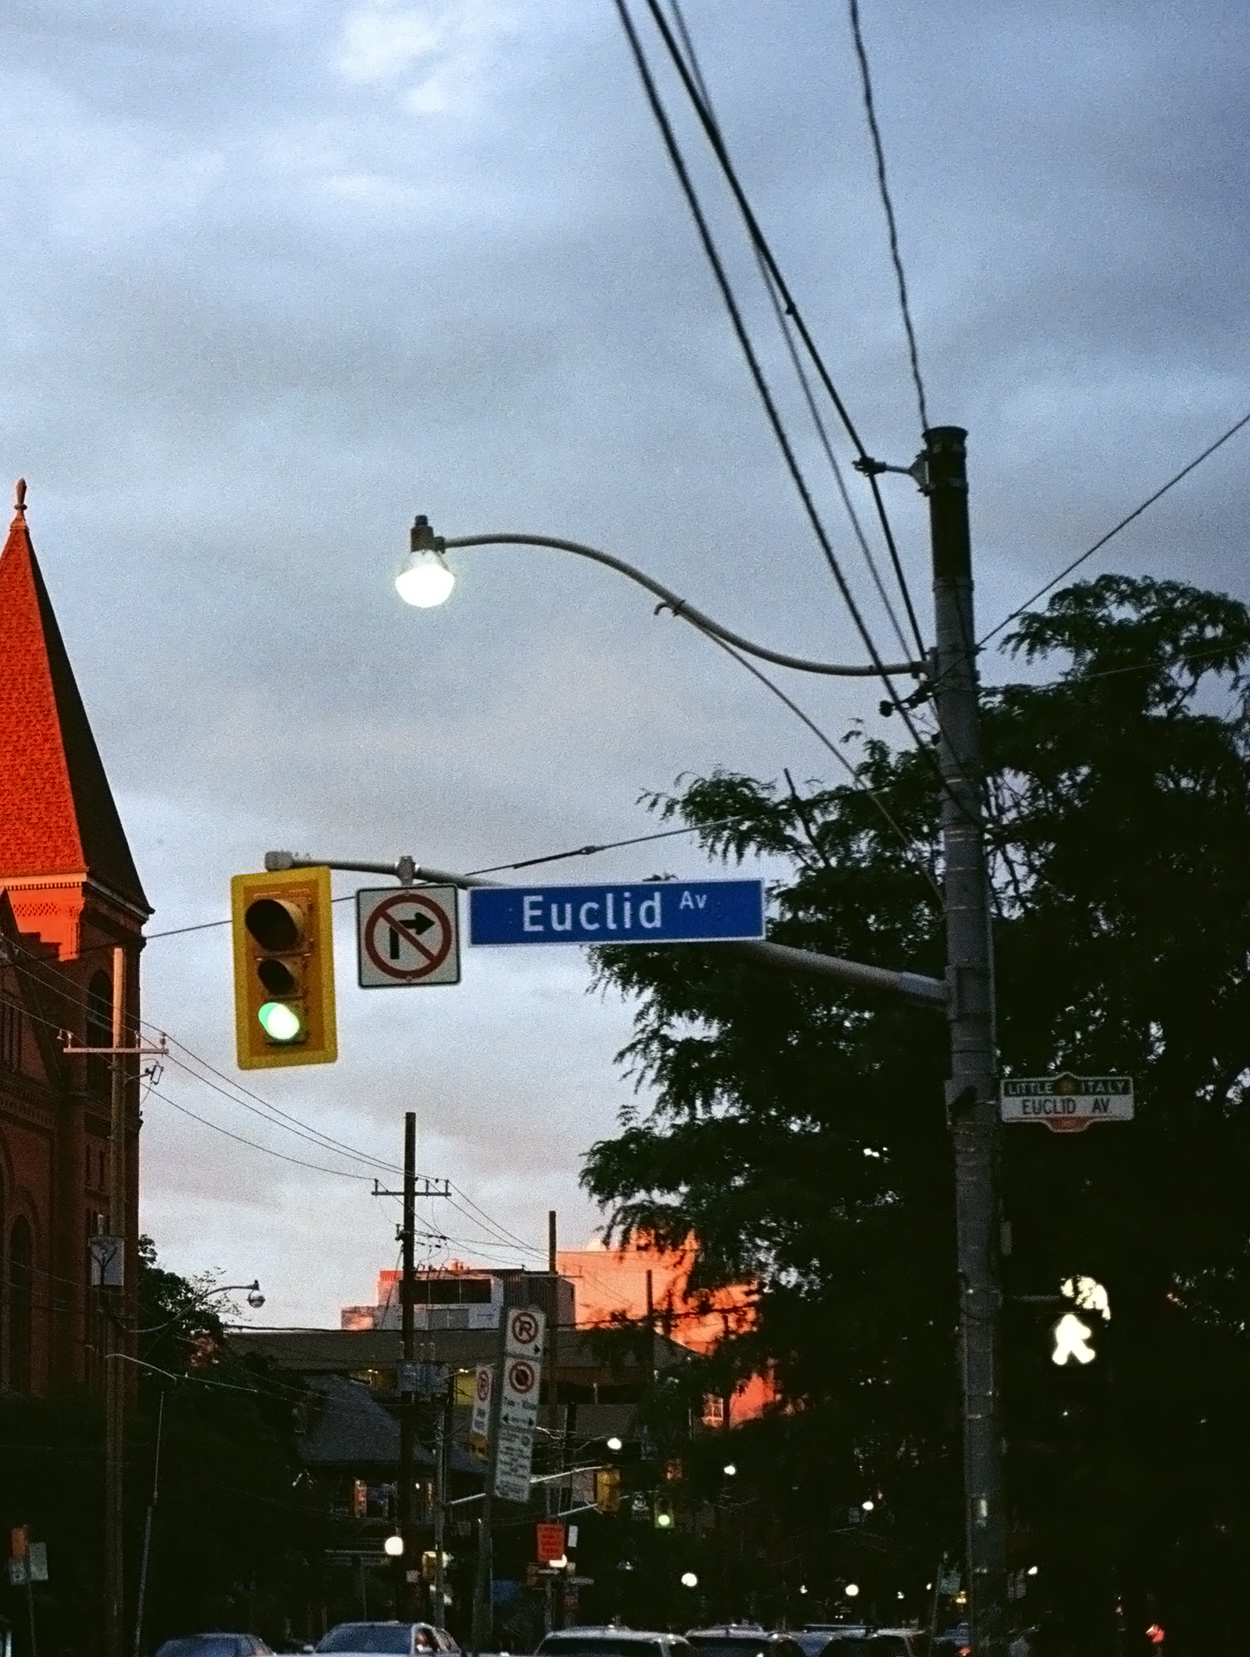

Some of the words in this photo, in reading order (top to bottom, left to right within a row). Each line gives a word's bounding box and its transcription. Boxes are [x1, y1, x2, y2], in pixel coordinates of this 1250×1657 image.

[523, 891, 663, 932] Euclid
[679, 890, 708, 910] Av
[1008, 1081, 1054, 1095] LITTLE
[1081, 1081, 1126, 1094] ITALY
[1021, 1098, 1077, 1115] EUCLID
